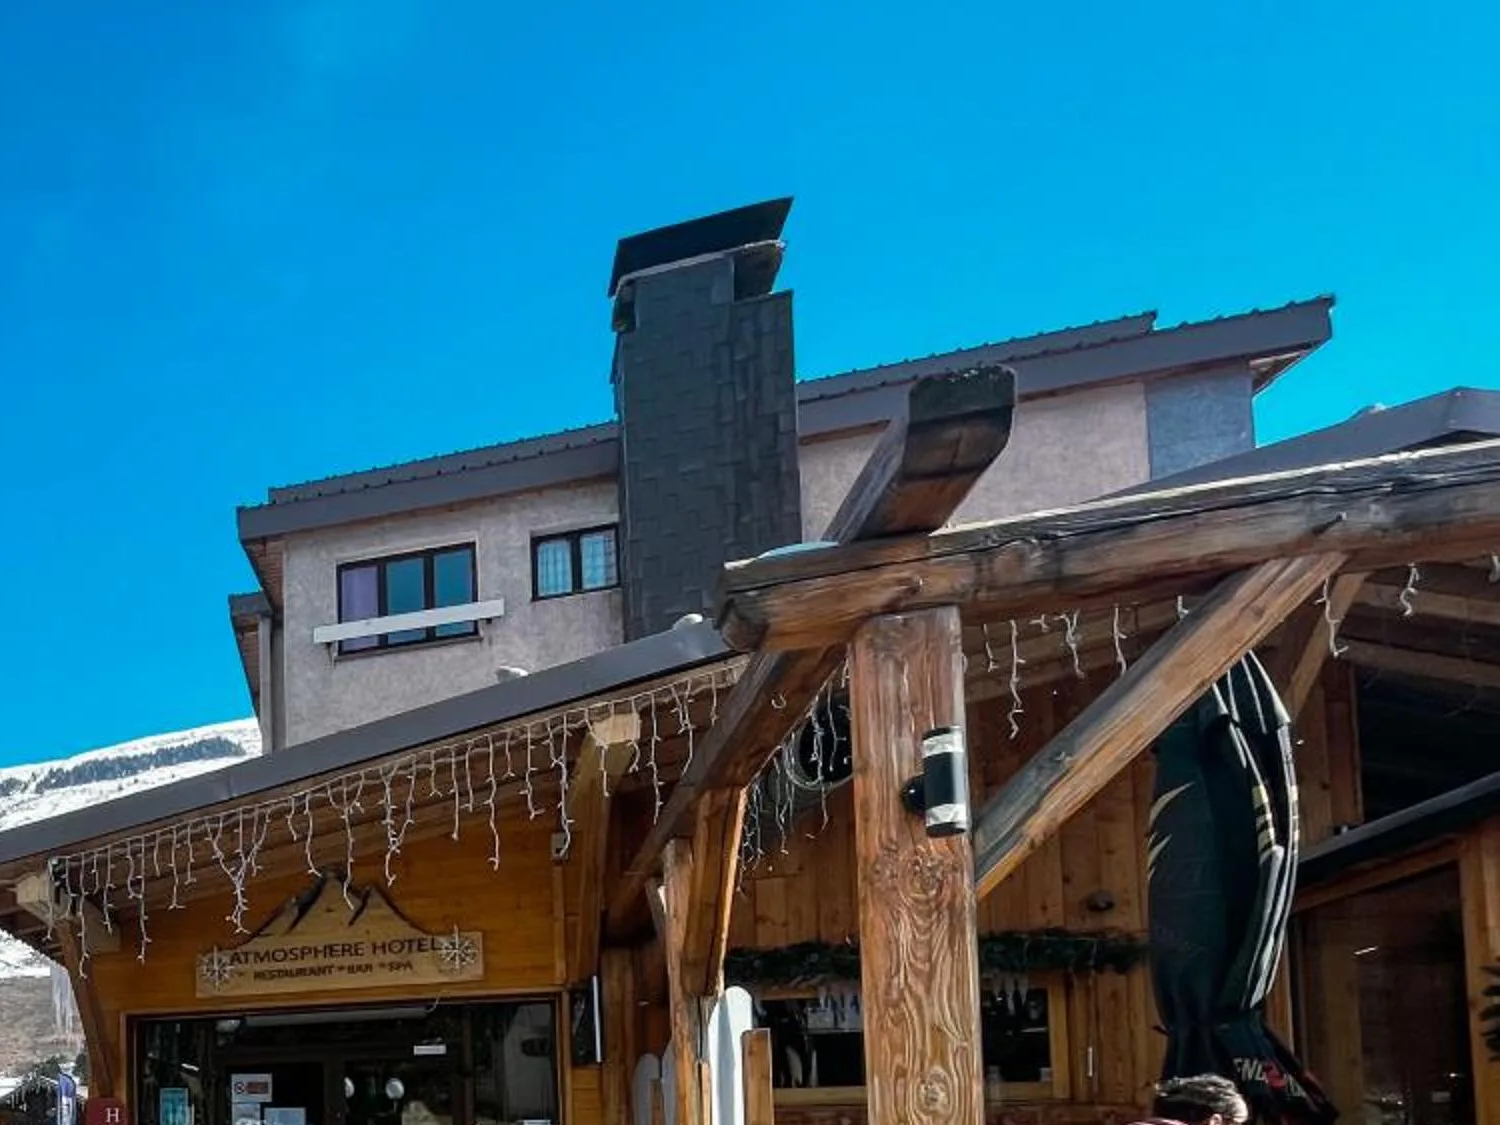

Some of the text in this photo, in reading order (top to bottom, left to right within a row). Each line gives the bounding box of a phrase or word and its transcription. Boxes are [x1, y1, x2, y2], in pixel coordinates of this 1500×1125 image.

[230, 937, 442, 965] ATMOSPHERE HOTEL
[253, 960, 413, 981] RESTAURANT BAR SPA
[105, 1107, 120, 1124] H
